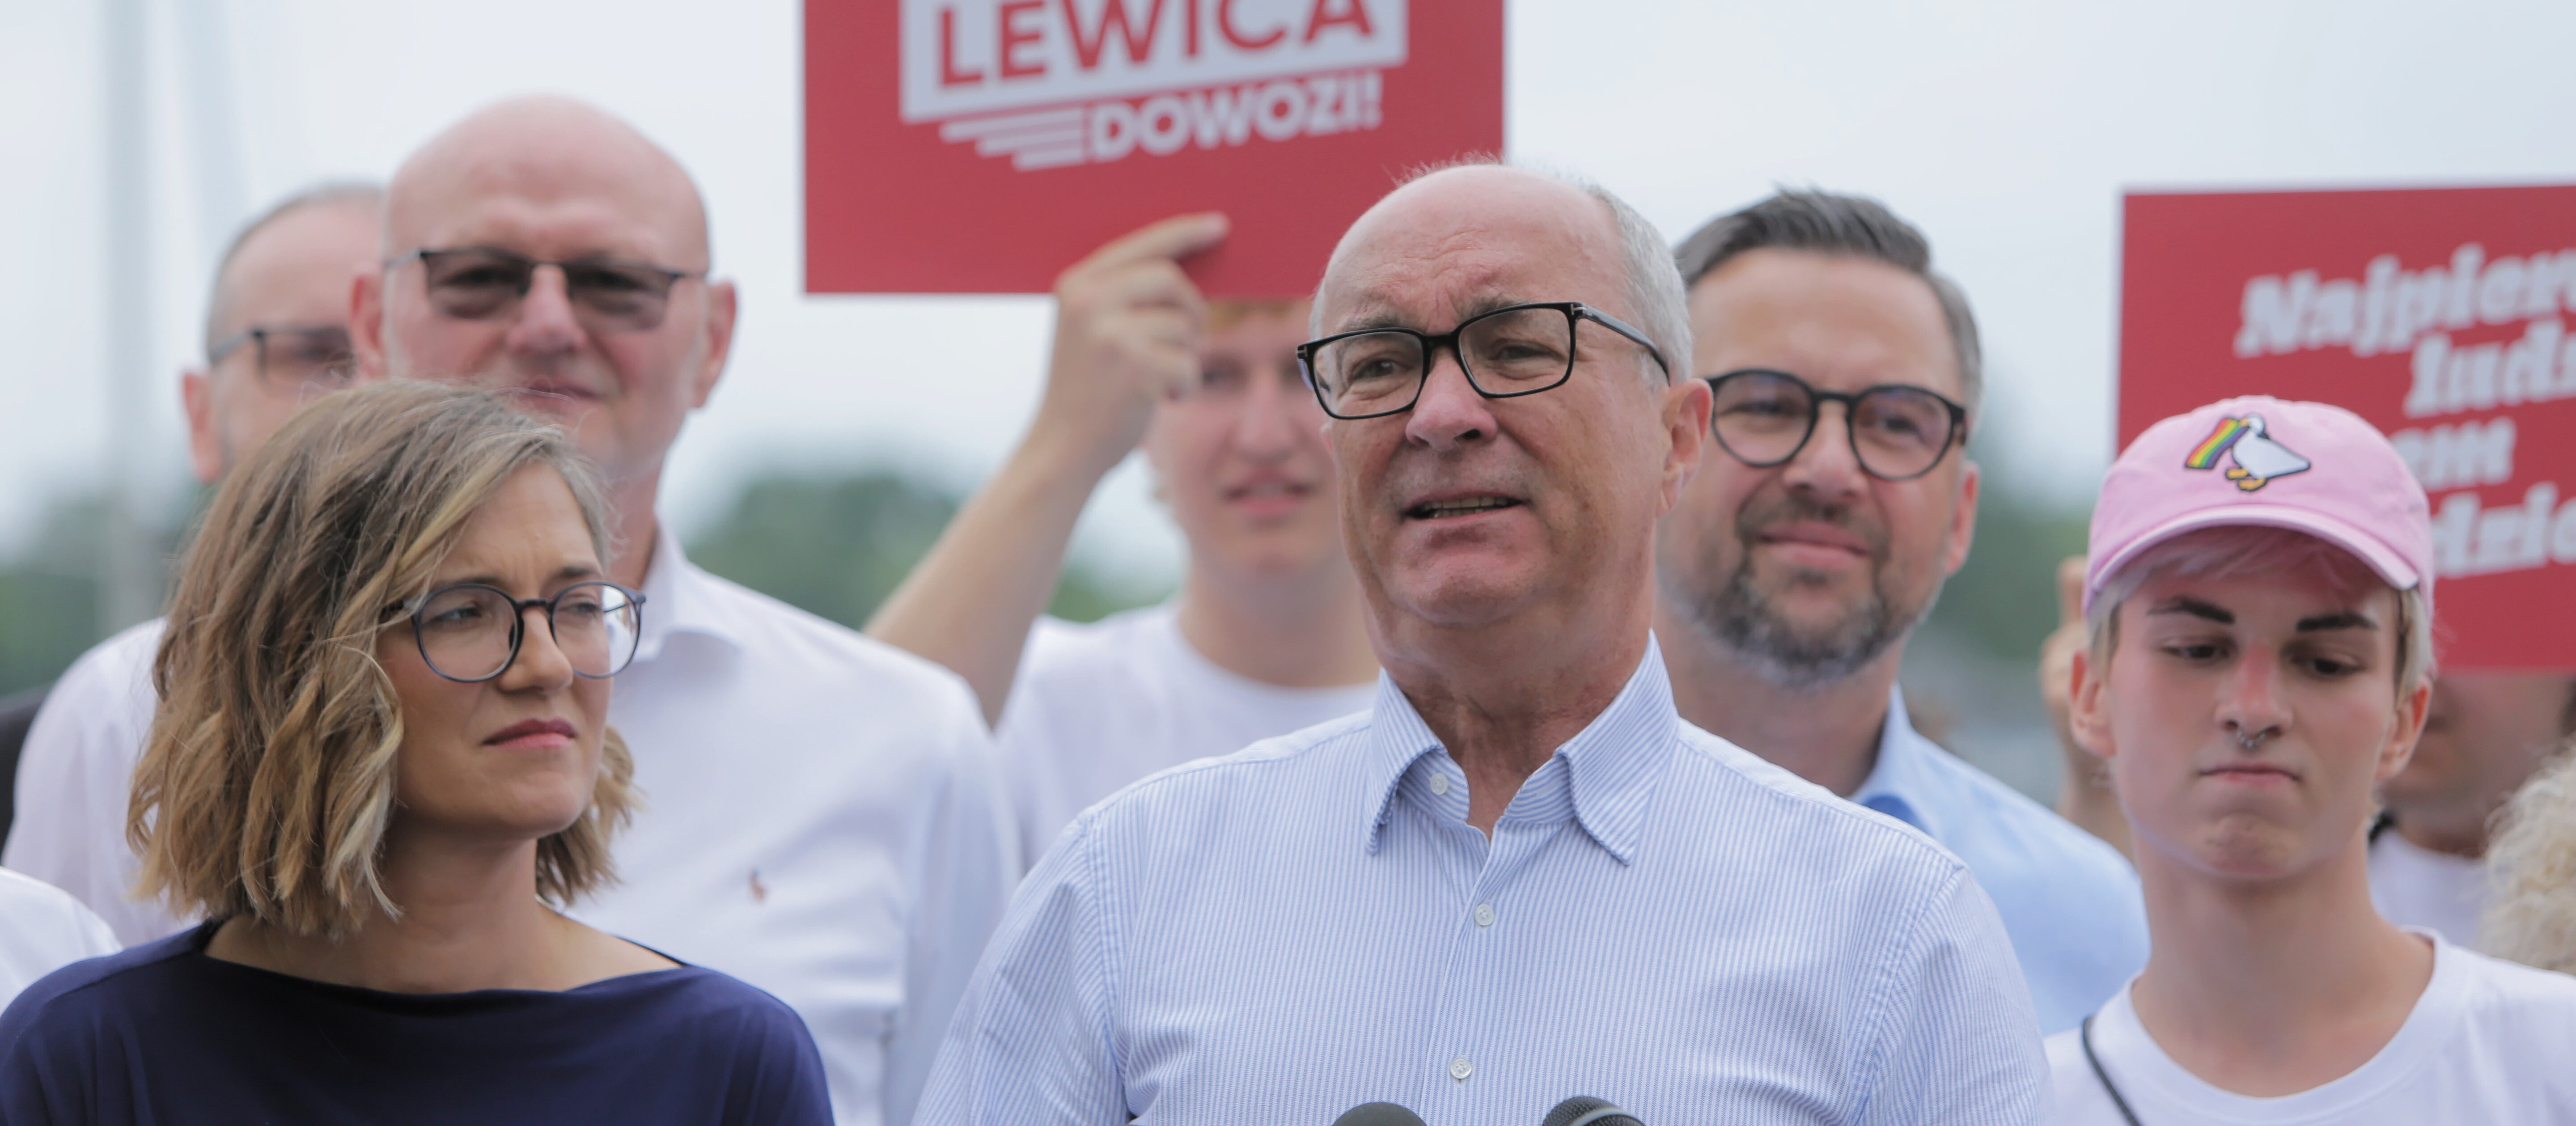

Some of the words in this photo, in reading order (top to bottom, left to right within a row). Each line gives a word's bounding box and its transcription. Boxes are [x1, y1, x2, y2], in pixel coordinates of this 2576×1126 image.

[939, 0, 1372, 87] LEWICA
[1091, 69, 1384, 162] DOWOZI!
[2235, 243, 2576, 357] Najpier
[2403, 318, 2576, 419] lud
